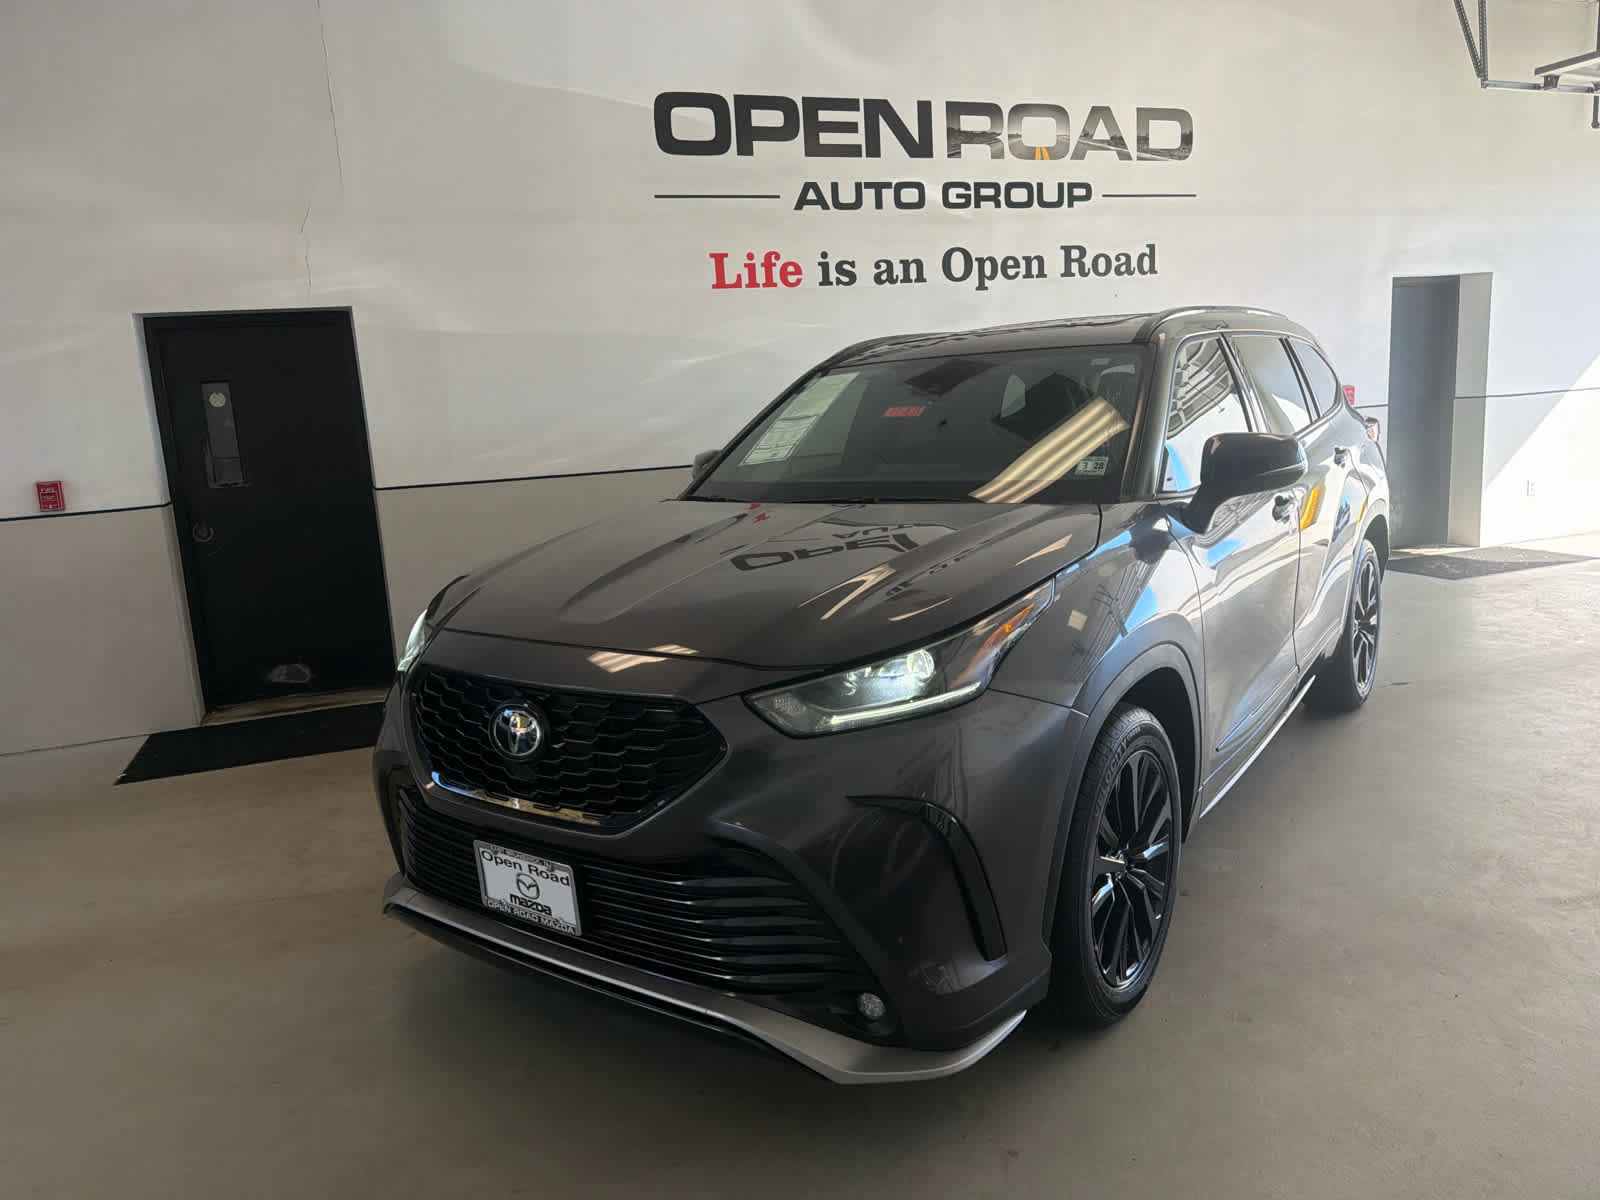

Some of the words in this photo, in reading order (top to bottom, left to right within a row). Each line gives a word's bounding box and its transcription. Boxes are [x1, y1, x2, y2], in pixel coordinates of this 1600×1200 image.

[653, 91, 934, 159] OPEN
[946, 100, 1193, 162] ROAD
[793, 181, 926, 211] AUTO
[940, 181, 1093, 209] GROUP
[709, 250, 804, 290] Life
[817, 250, 858, 287] is
[873, 252, 927, 285] an
[941, 246, 1046, 291] Open
[1060, 244, 1159, 278] Road
[481, 849, 522, 872] Open
[528, 864, 570, 886] Road
